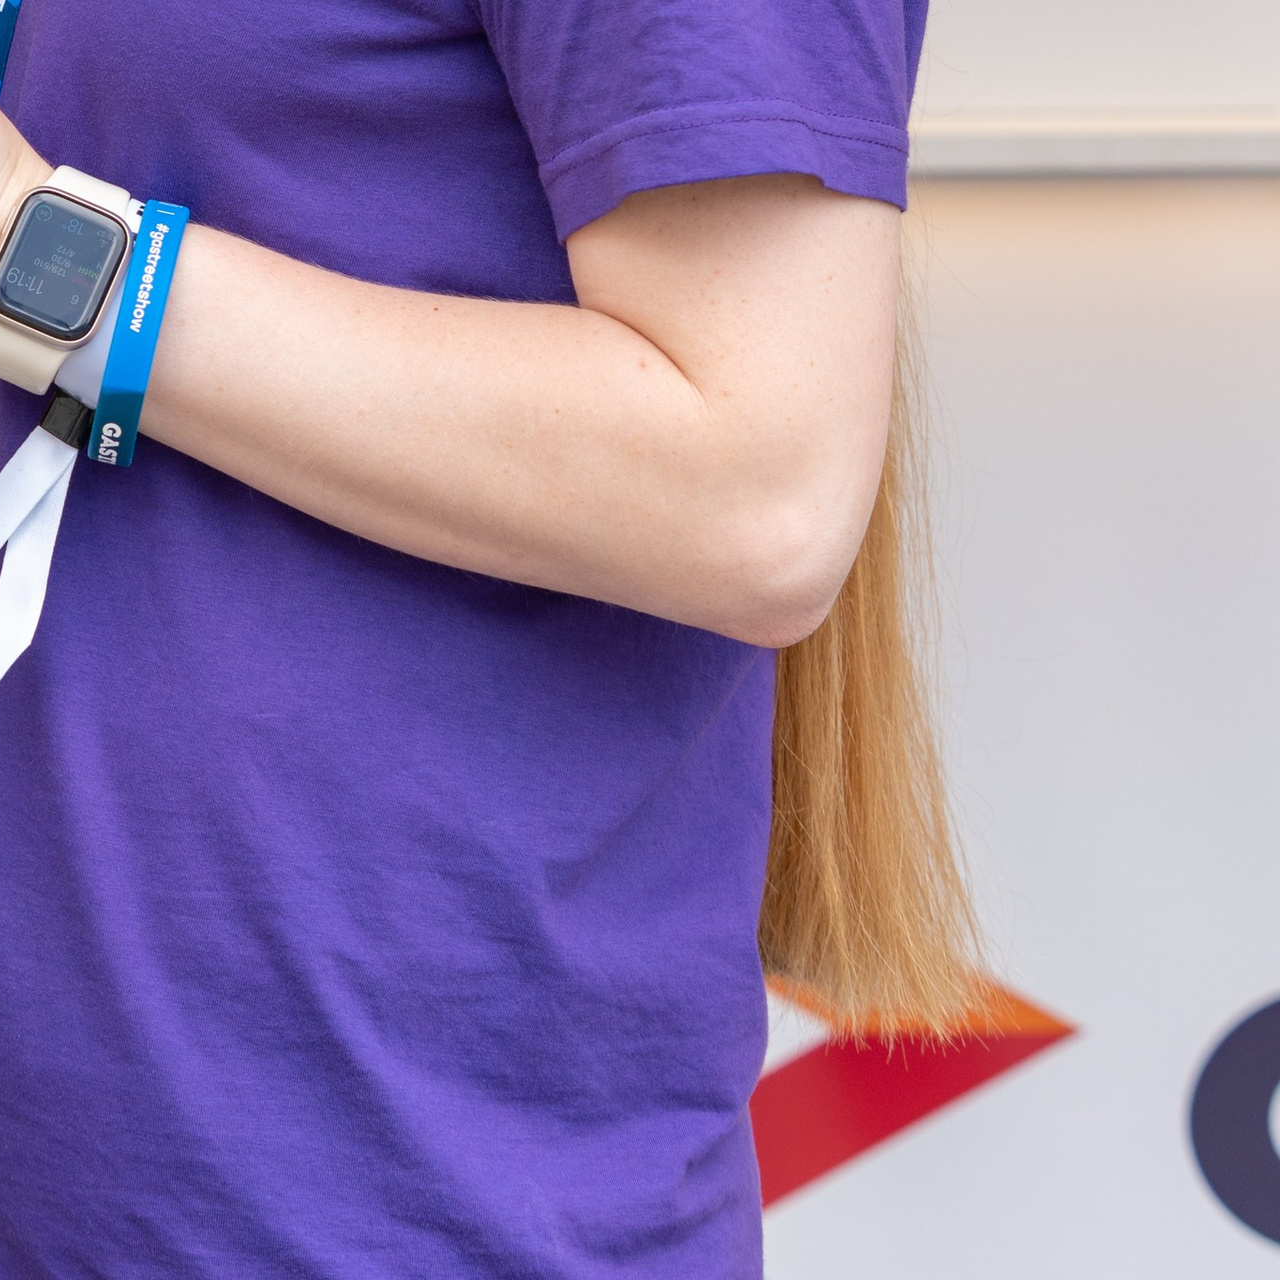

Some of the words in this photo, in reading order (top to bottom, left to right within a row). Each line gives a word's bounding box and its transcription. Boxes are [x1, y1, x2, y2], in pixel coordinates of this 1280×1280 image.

[56, 245, 76, 258] 4/12
[34, 258, 67, 278] 129/510
[51, 254, 71, 268] 9/30
[5, 266, 44, 296] 11:19
[129, 222, 170, 334] #gastreetshow
[70, 294, 80, 305] 6
